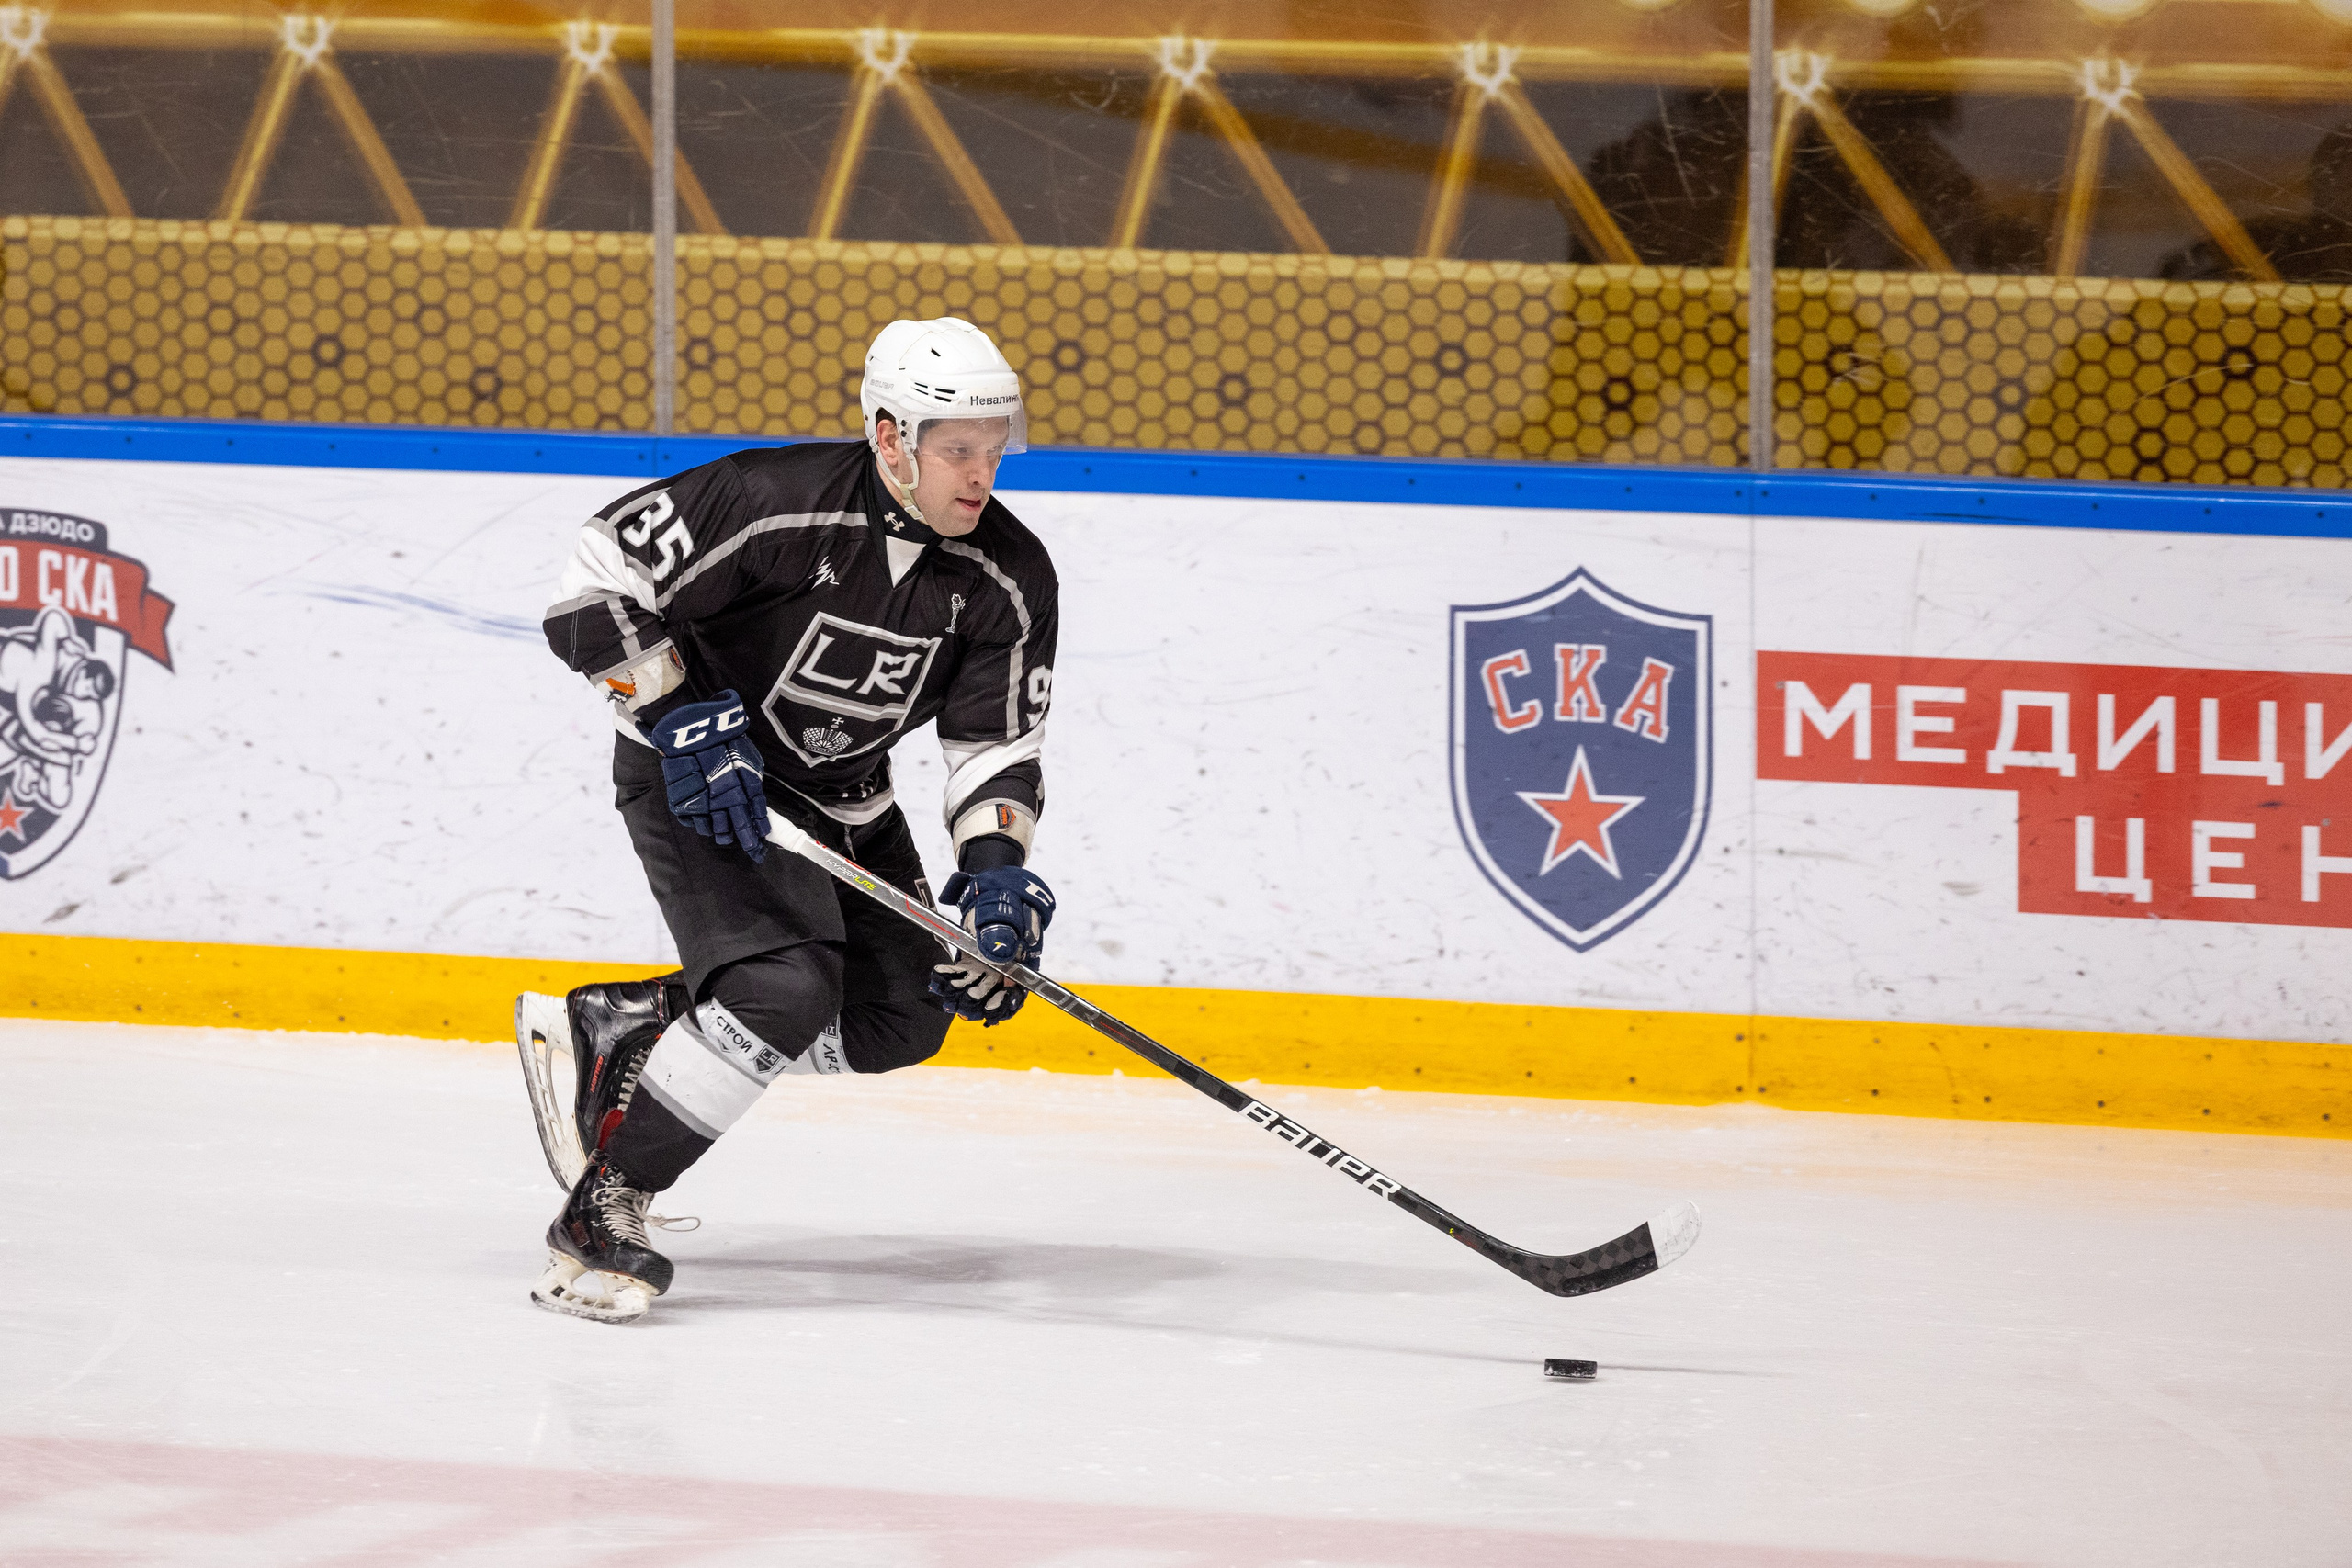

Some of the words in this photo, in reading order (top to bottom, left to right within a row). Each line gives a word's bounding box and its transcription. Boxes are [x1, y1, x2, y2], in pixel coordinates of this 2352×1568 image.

[9, 513, 96, 542] ДЗЮДО
[622, 491, 695, 581] 95
[38, 549, 119, 623] СКА
[797, 632, 922, 695] LR
[1481, 643, 1675, 744] СКА
[672, 702, 749, 749] CC
[1784, 680, 2352, 786] МЕДИЦИ
[825, 859, 877, 891] HYPERLITE
[2075, 815, 2352, 904] ЦЕН
[1007, 963, 1101, 1028] POR
[717, 1015, 753, 1053] СТРОЙ
